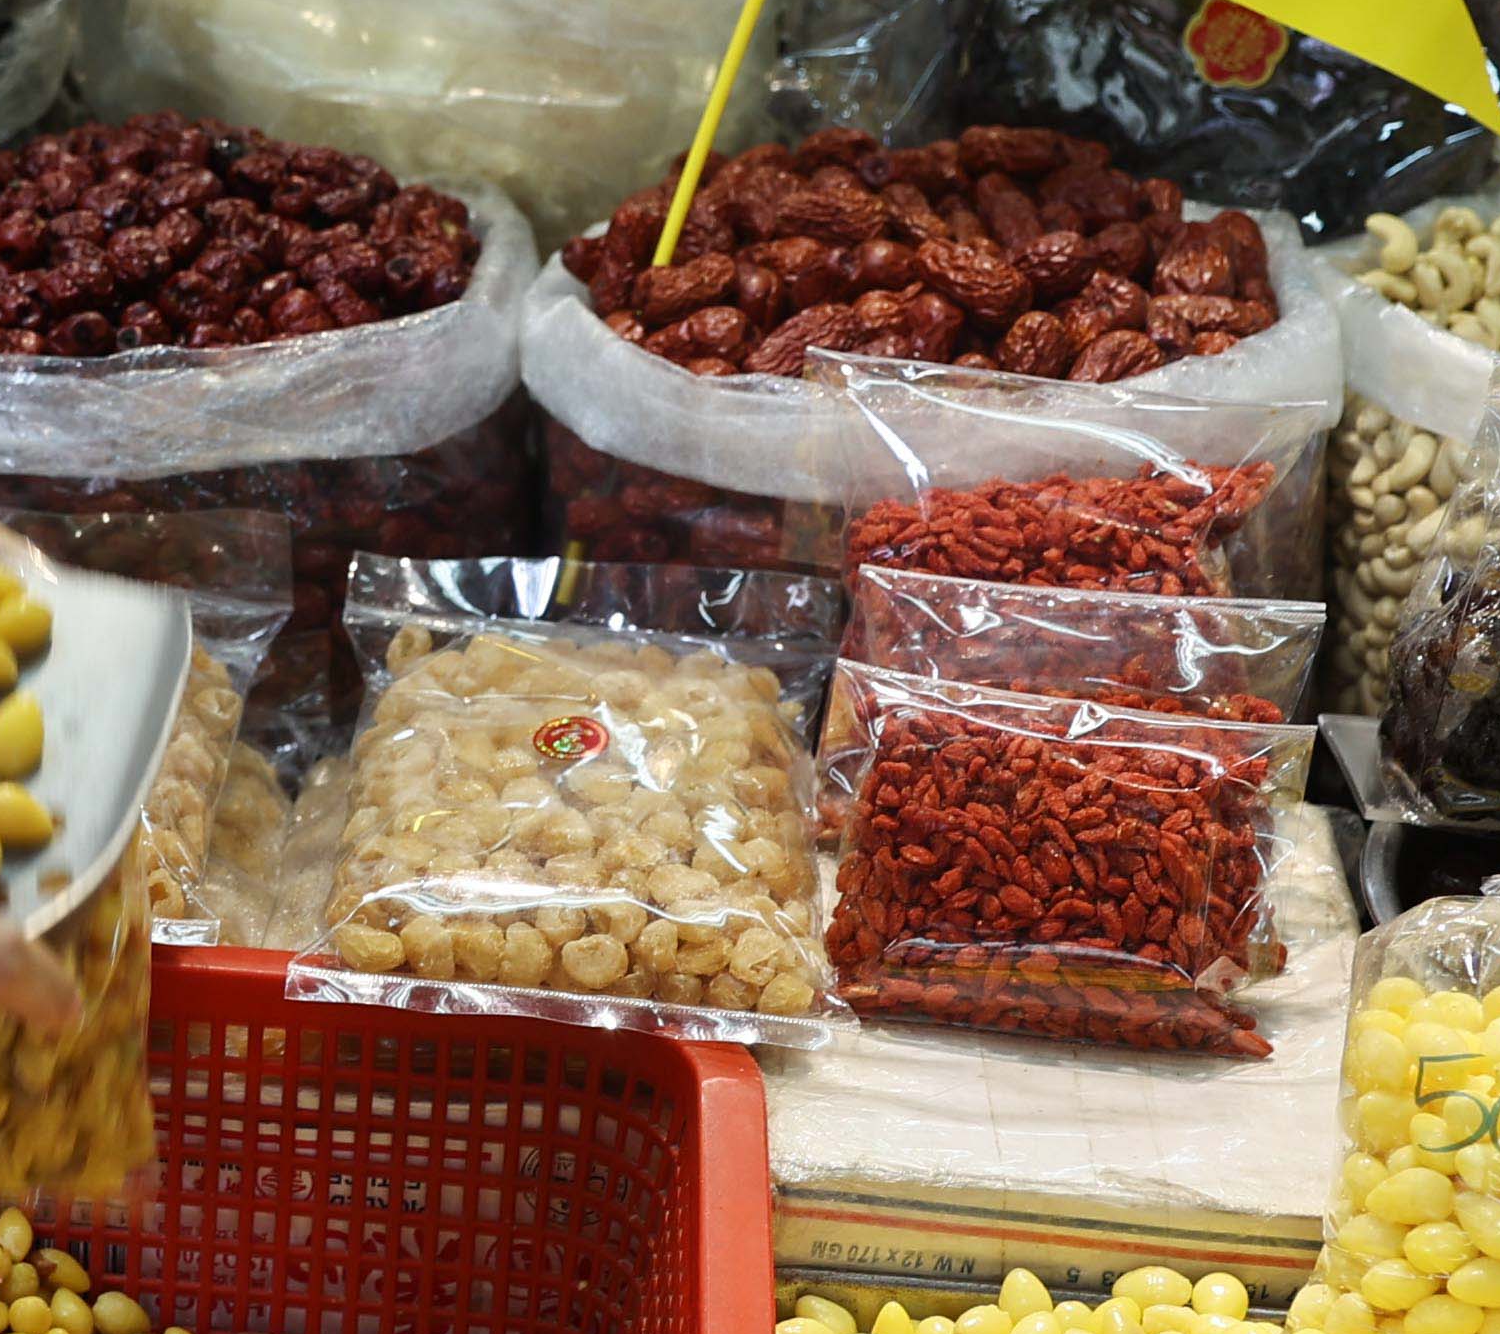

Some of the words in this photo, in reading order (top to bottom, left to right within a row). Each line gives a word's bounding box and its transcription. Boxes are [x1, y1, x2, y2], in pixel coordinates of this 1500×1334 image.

[810, 1240, 843, 1261] GM
[847, 1245, 881, 1267] 170
[901, 1250, 924, 1269] 12
[1066, 1267, 1081, 1283] 5
